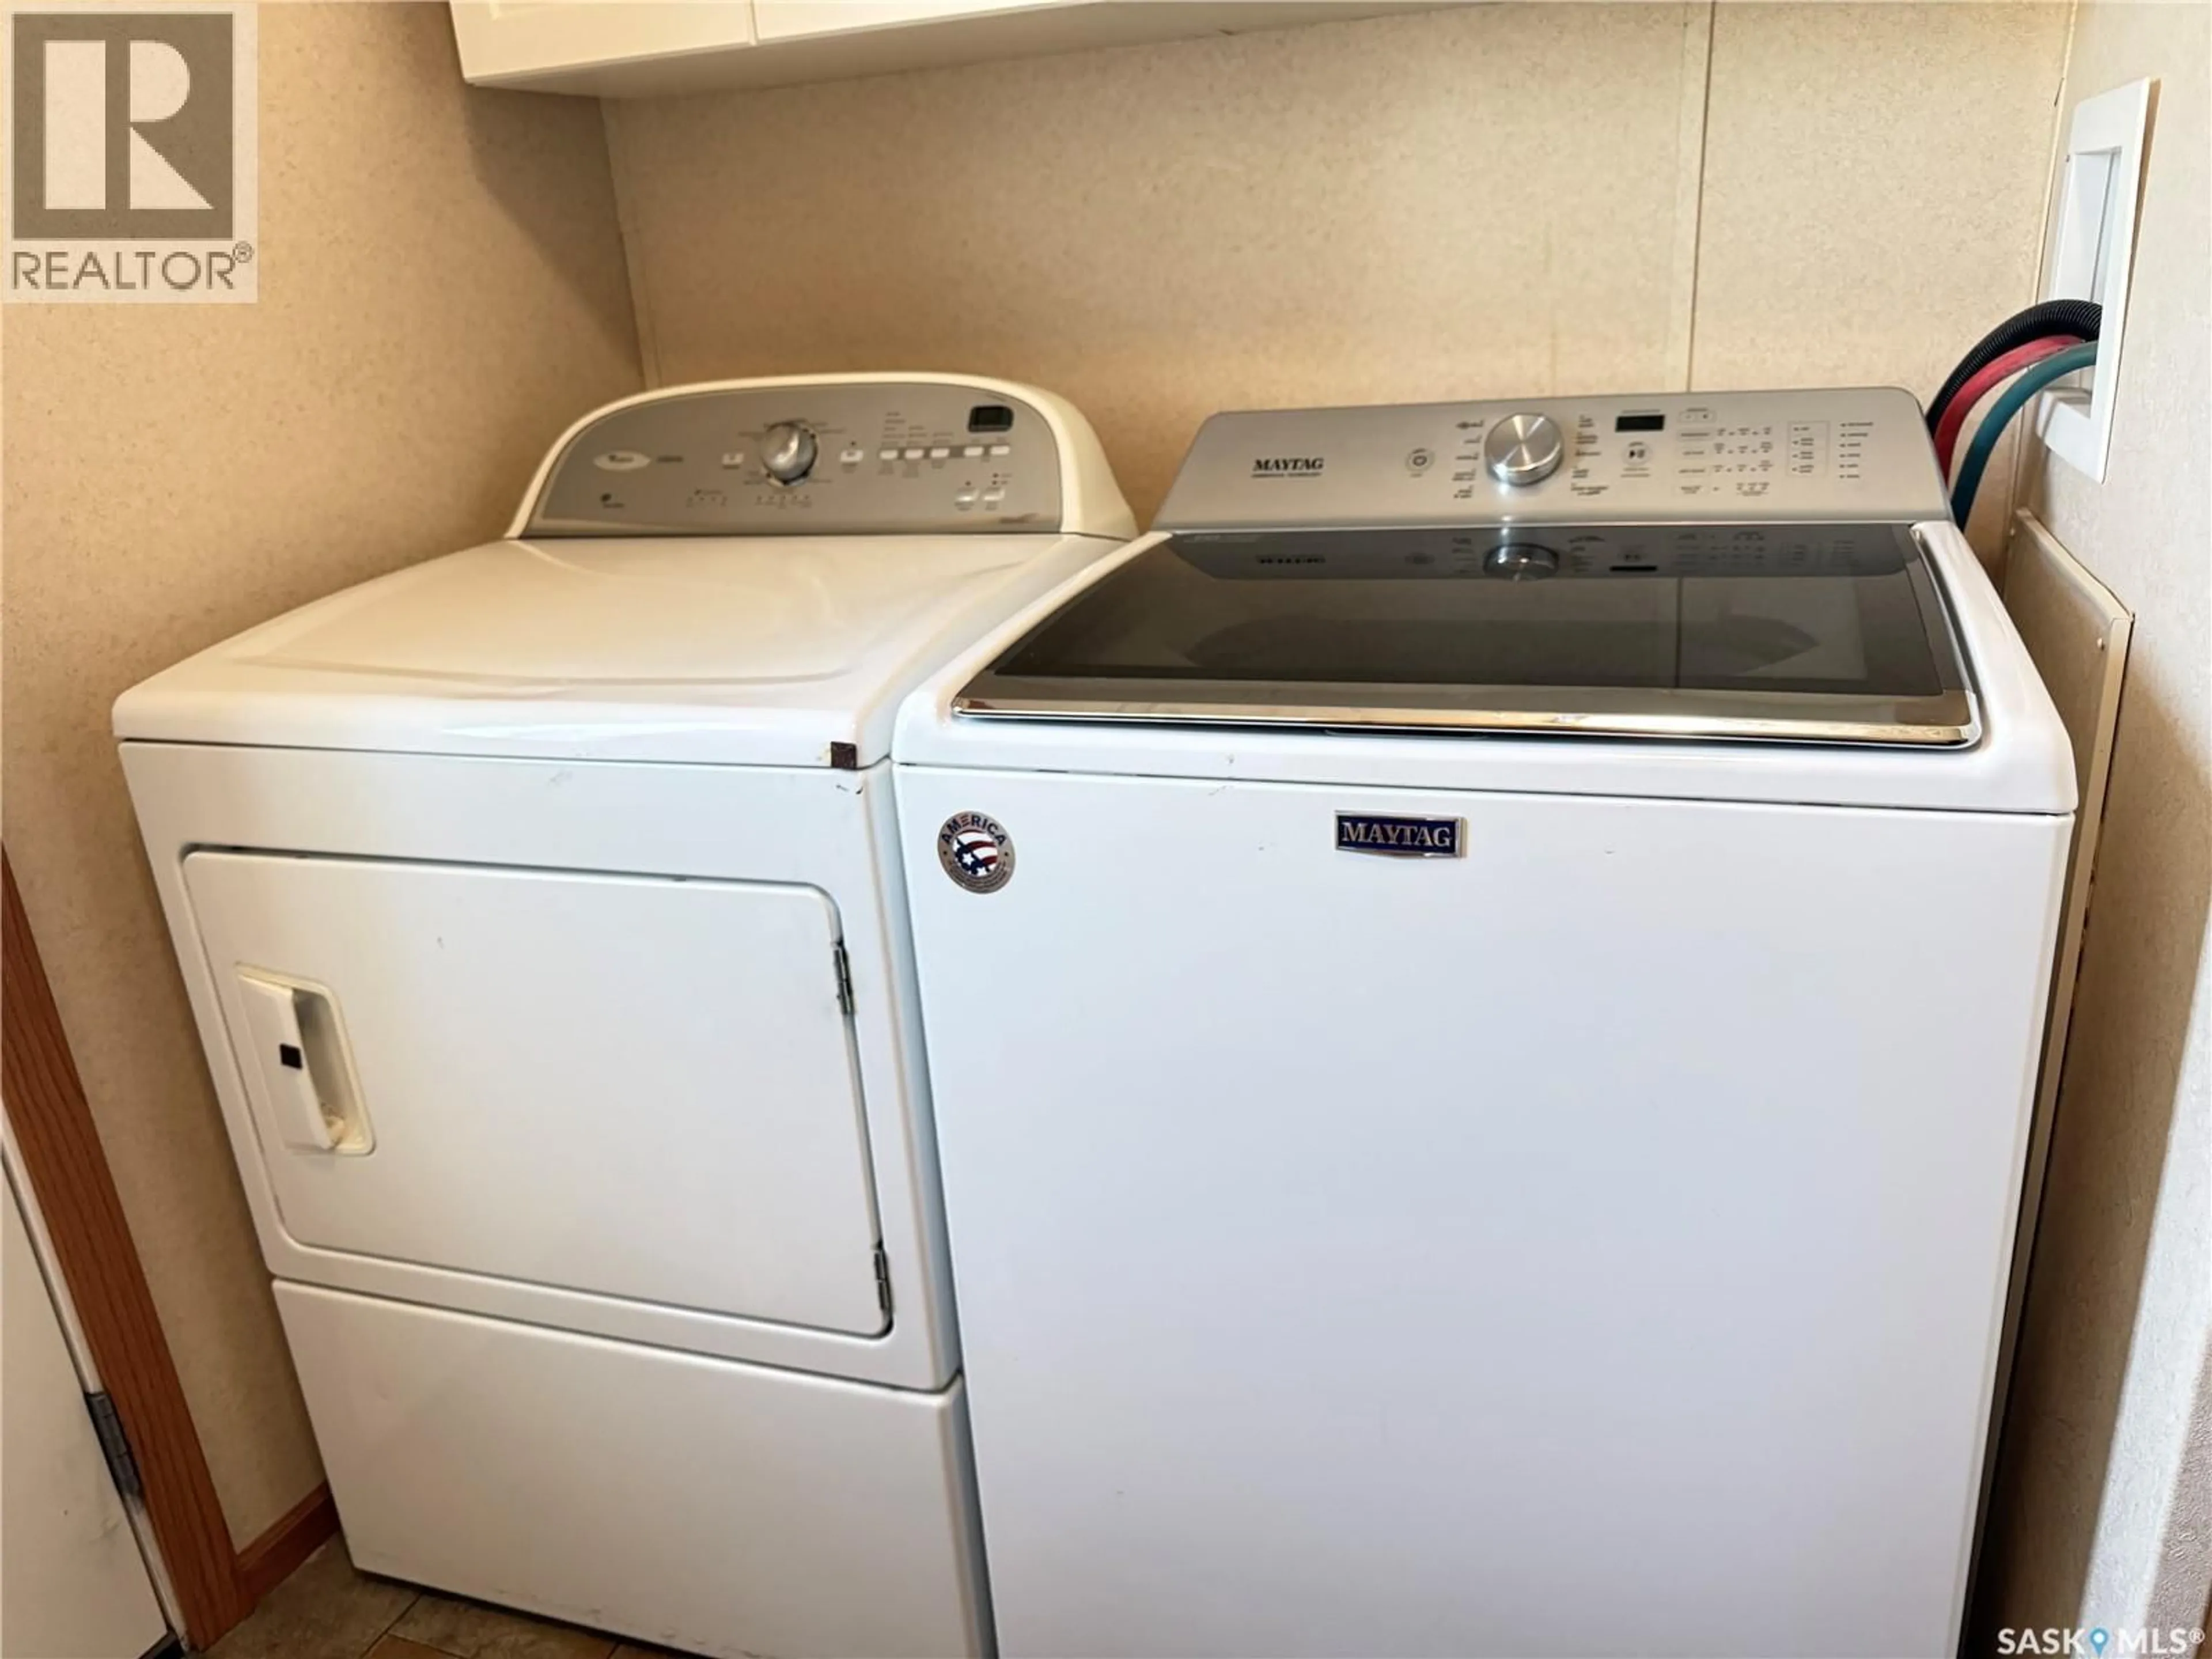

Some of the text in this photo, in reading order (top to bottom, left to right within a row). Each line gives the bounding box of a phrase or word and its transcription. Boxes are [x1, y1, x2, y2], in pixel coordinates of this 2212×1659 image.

[1252, 457, 1324, 471] MAYTAG
[941, 813, 1006, 846] AMERICA
[1341, 821, 1452, 847] MAYTAG
